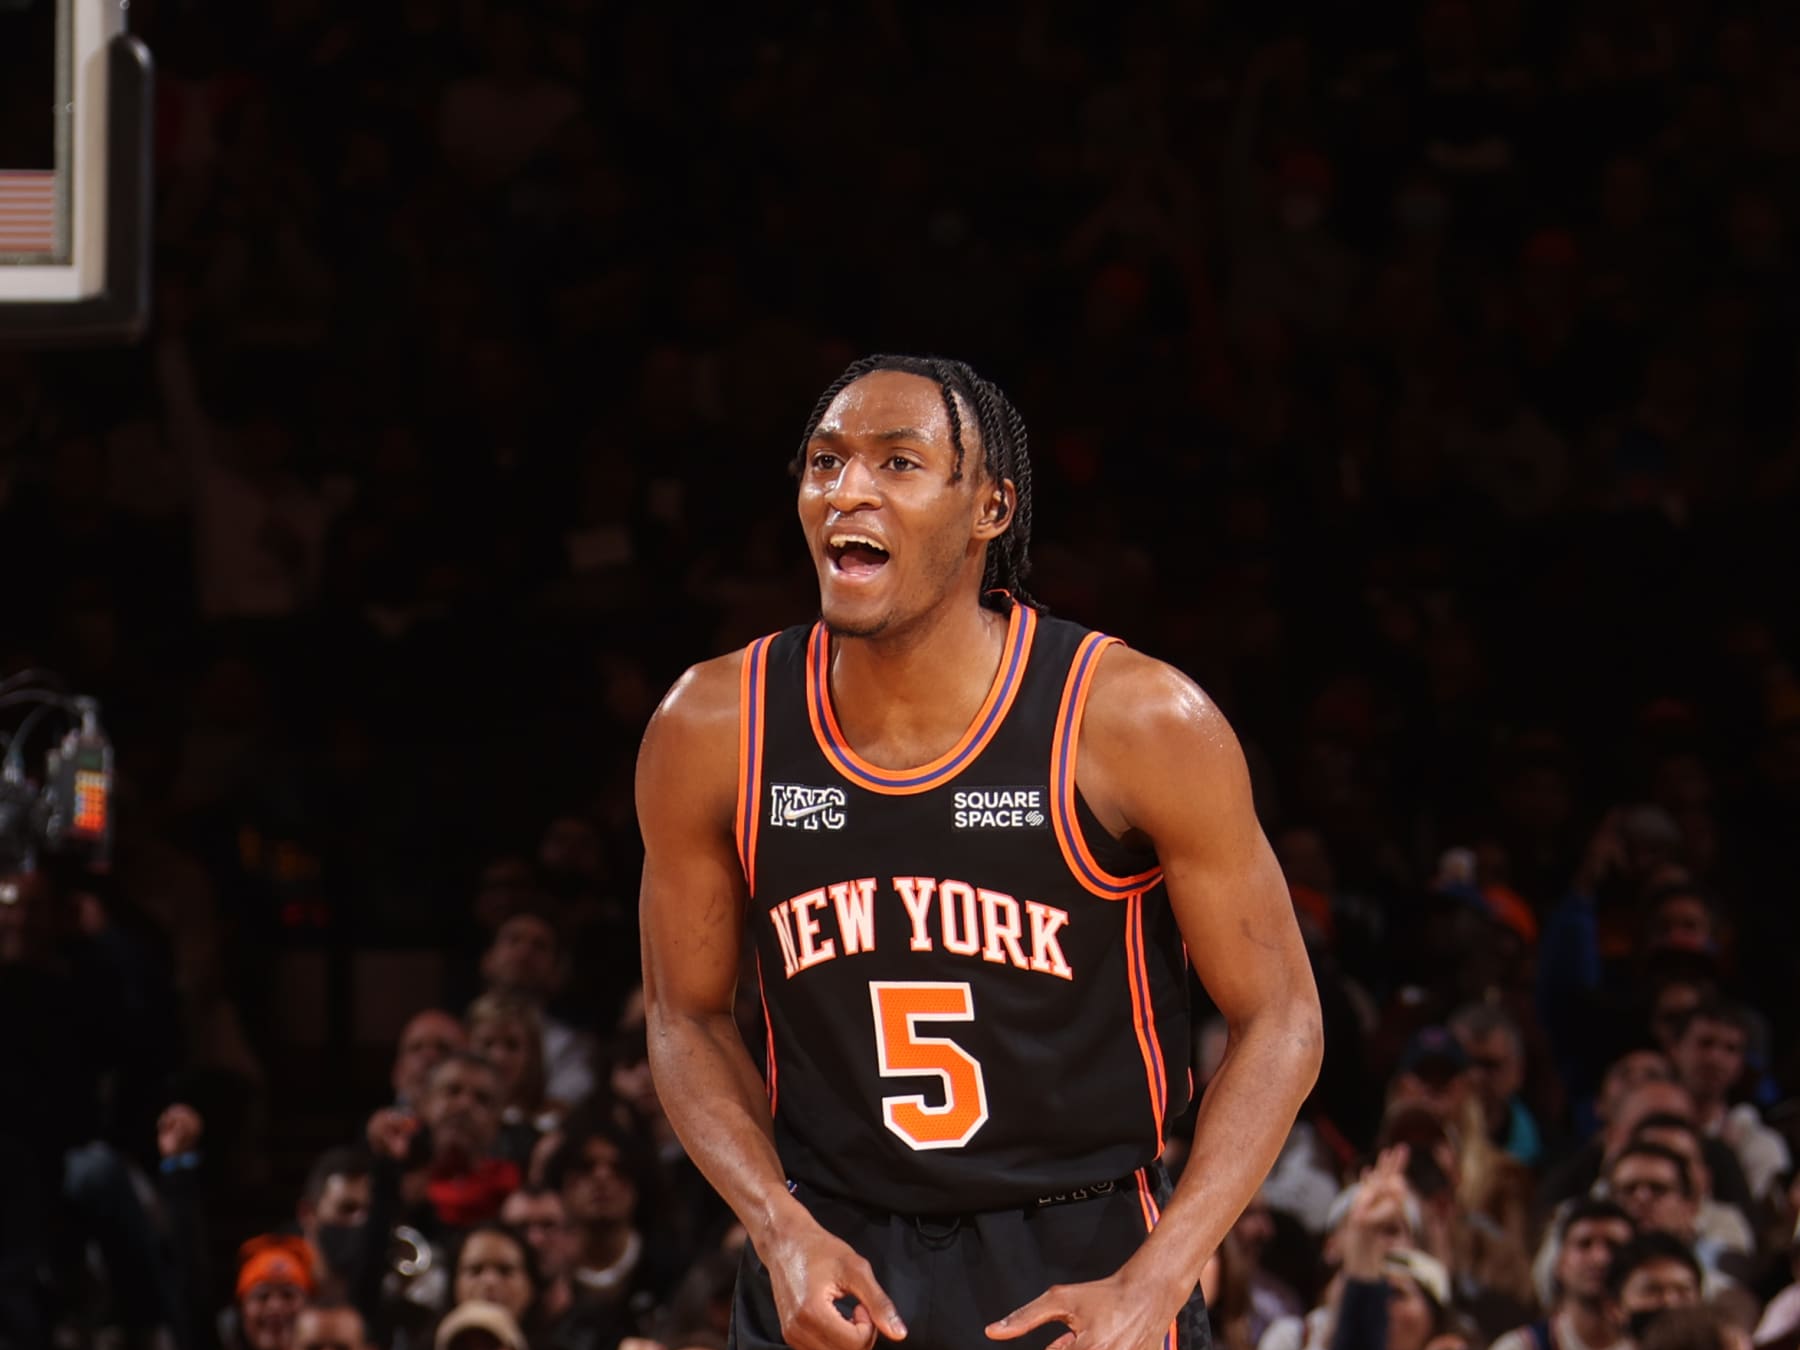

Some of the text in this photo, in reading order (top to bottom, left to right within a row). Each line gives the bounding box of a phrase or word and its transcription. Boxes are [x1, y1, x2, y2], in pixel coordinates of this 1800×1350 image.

[771, 785, 845, 830] NYC
[954, 791, 1040, 809] SQUARE
[955, 810, 1024, 828] SPACE
[769, 876, 1073, 981] NEW YORK
[869, 981, 989, 1151] 5
